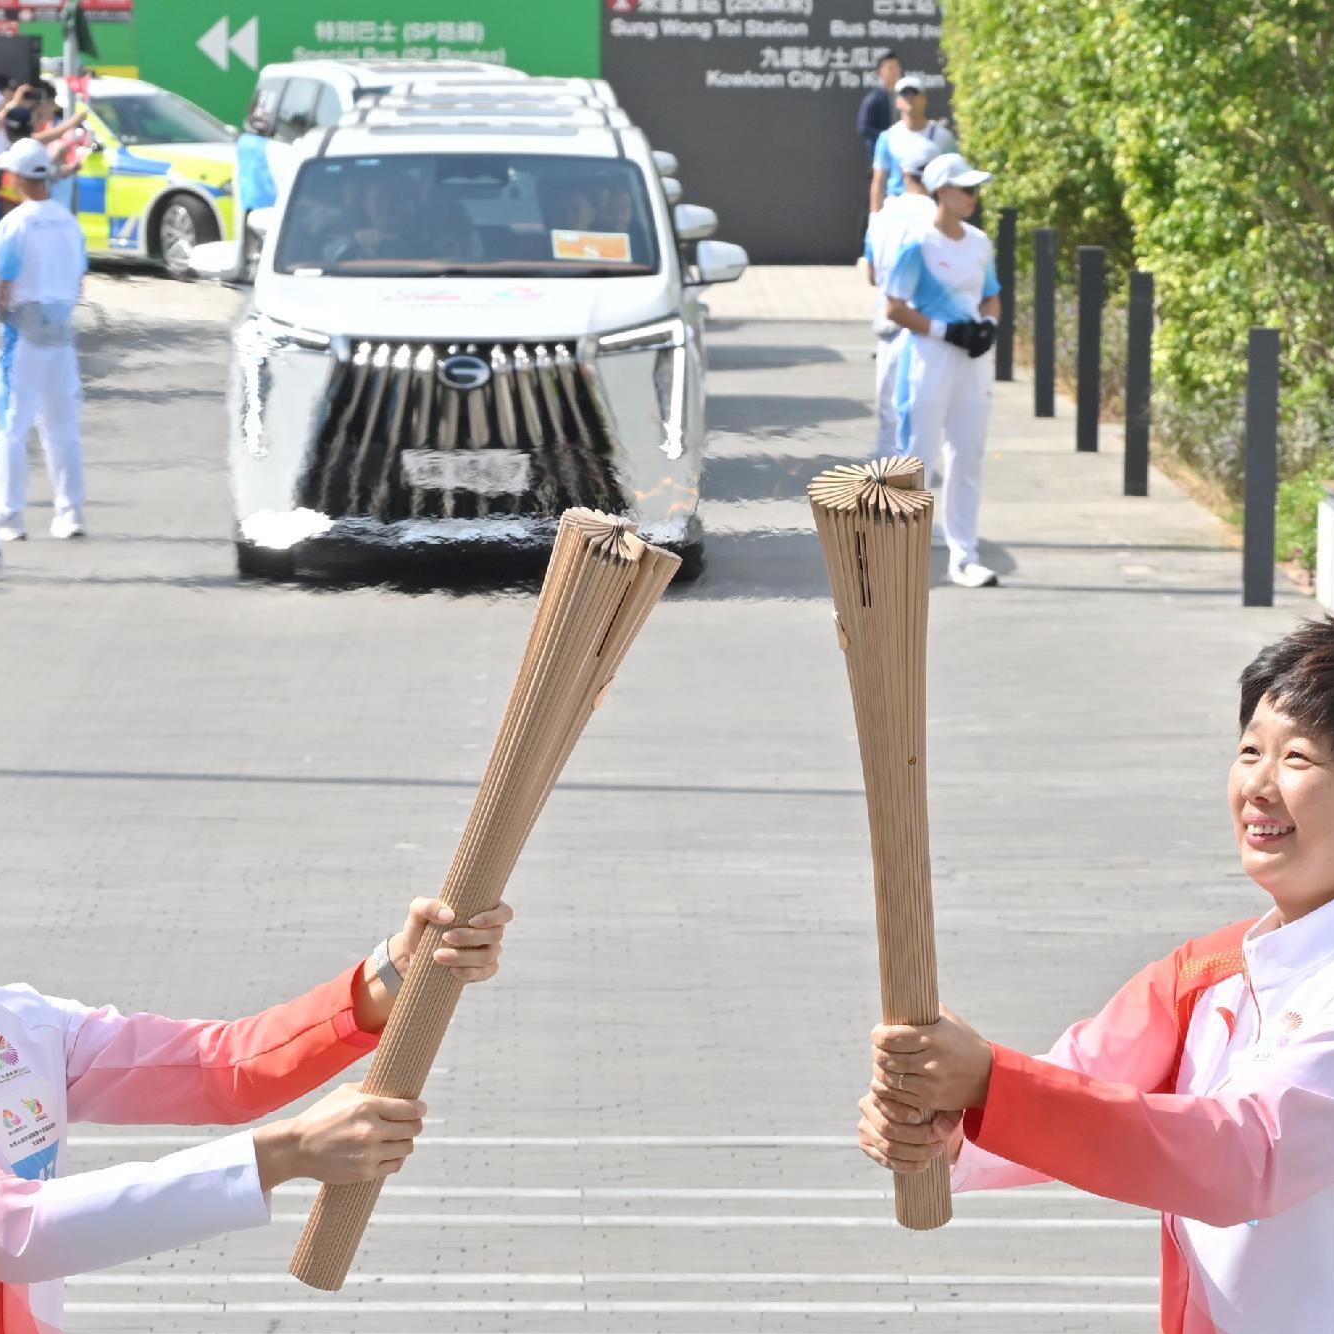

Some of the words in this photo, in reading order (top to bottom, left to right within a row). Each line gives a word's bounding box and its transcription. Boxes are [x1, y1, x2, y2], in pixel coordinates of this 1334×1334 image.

[610, 18, 658, 40] Sung
[659, 18, 713, 41] Wong
[714, 19, 743, 37] Toi
[744, 19, 809, 37] Station
[830, 19, 866, 37] Bus
[868, 19, 921, 40] Stops
[705, 69, 786, 89] Kowloon
[787, 69, 825, 91] City
